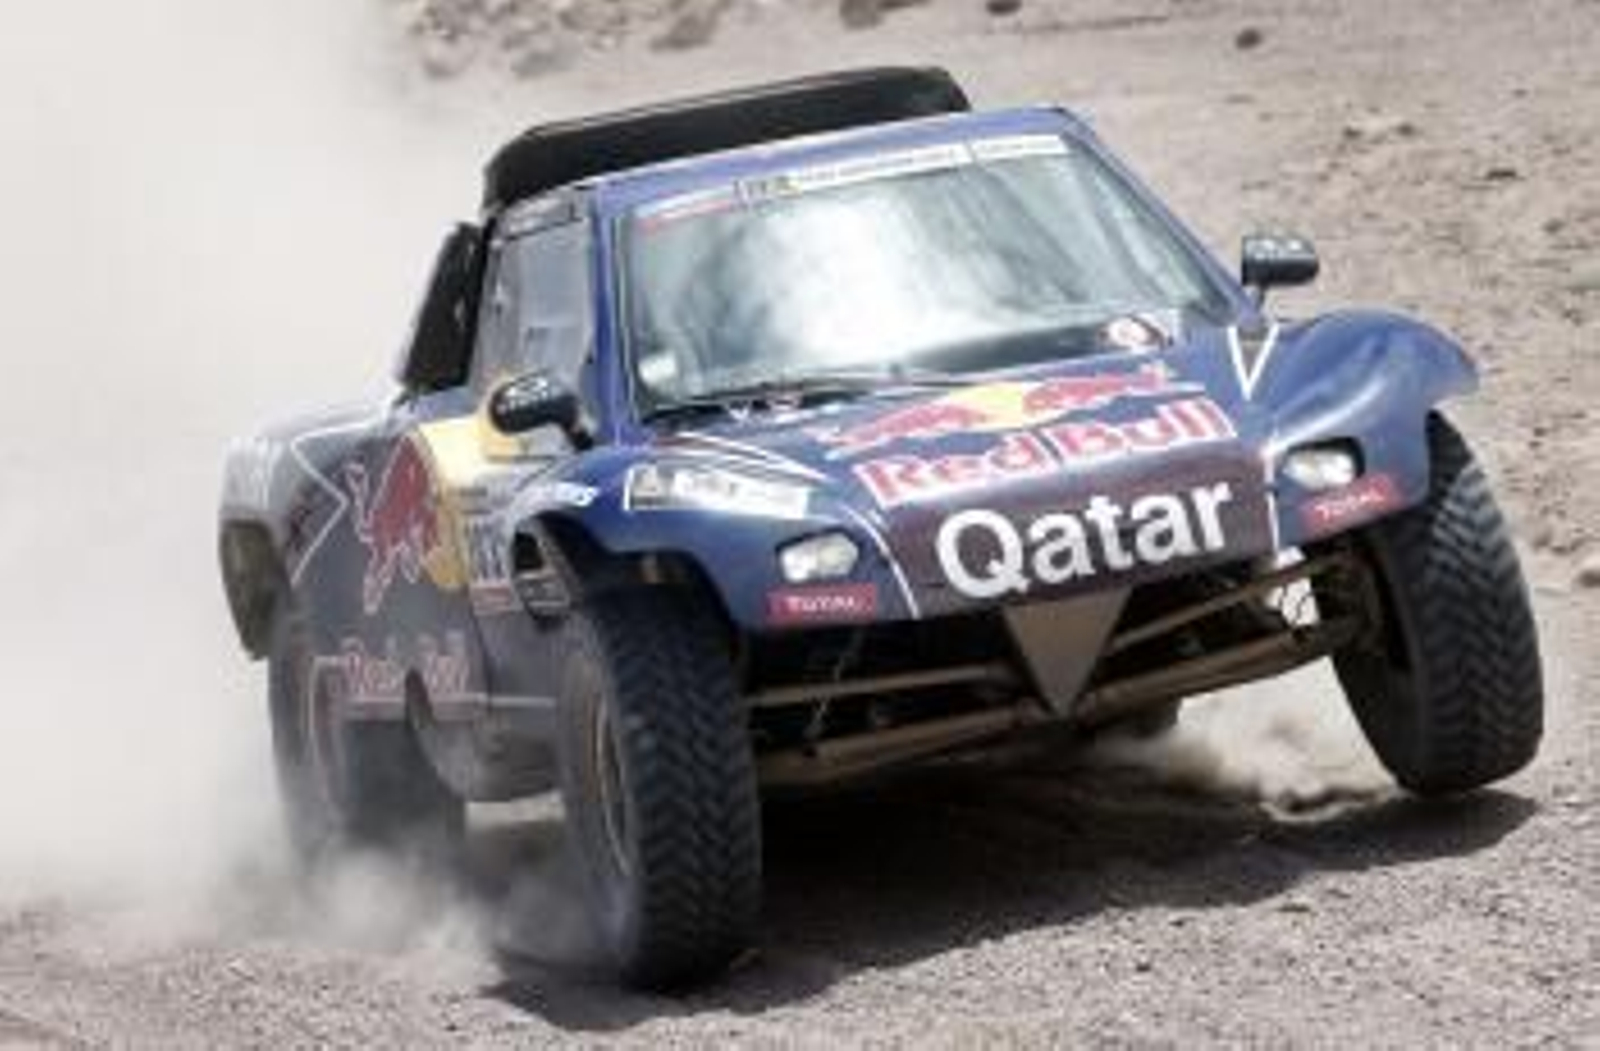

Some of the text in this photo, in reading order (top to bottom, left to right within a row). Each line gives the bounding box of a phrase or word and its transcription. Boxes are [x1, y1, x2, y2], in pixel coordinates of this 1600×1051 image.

[851, 431, 1061, 511] Red
[1040, 397, 1238, 462] Bull
[934, 479, 1234, 599] Qatar
